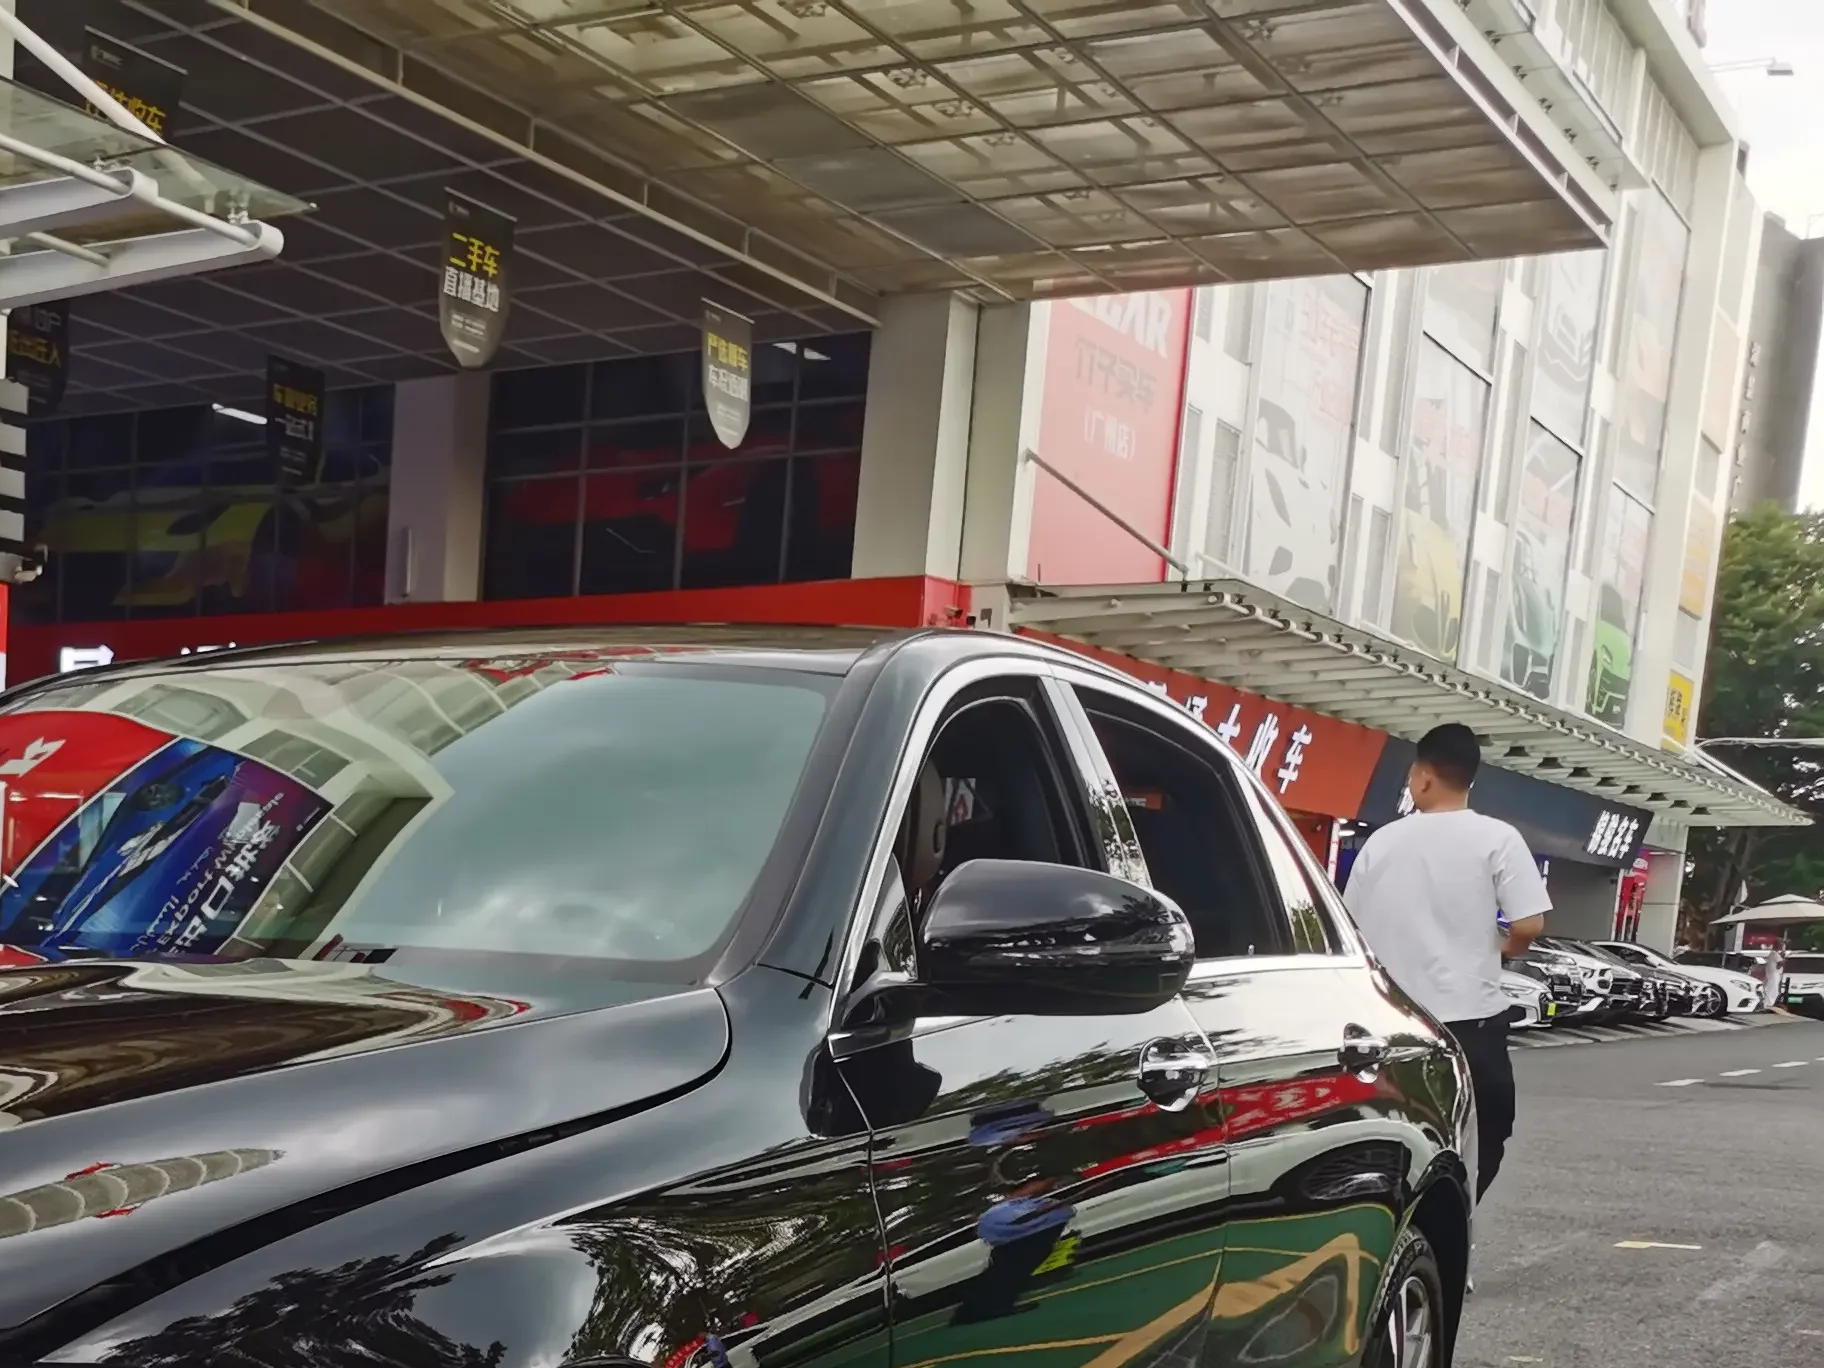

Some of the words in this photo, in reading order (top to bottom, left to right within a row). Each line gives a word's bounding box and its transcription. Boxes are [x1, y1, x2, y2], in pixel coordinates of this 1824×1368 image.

[450, 232, 500, 278] 二手车
[443, 266, 500, 312] 直播基地
[1067, 291, 1172, 358] CAR
